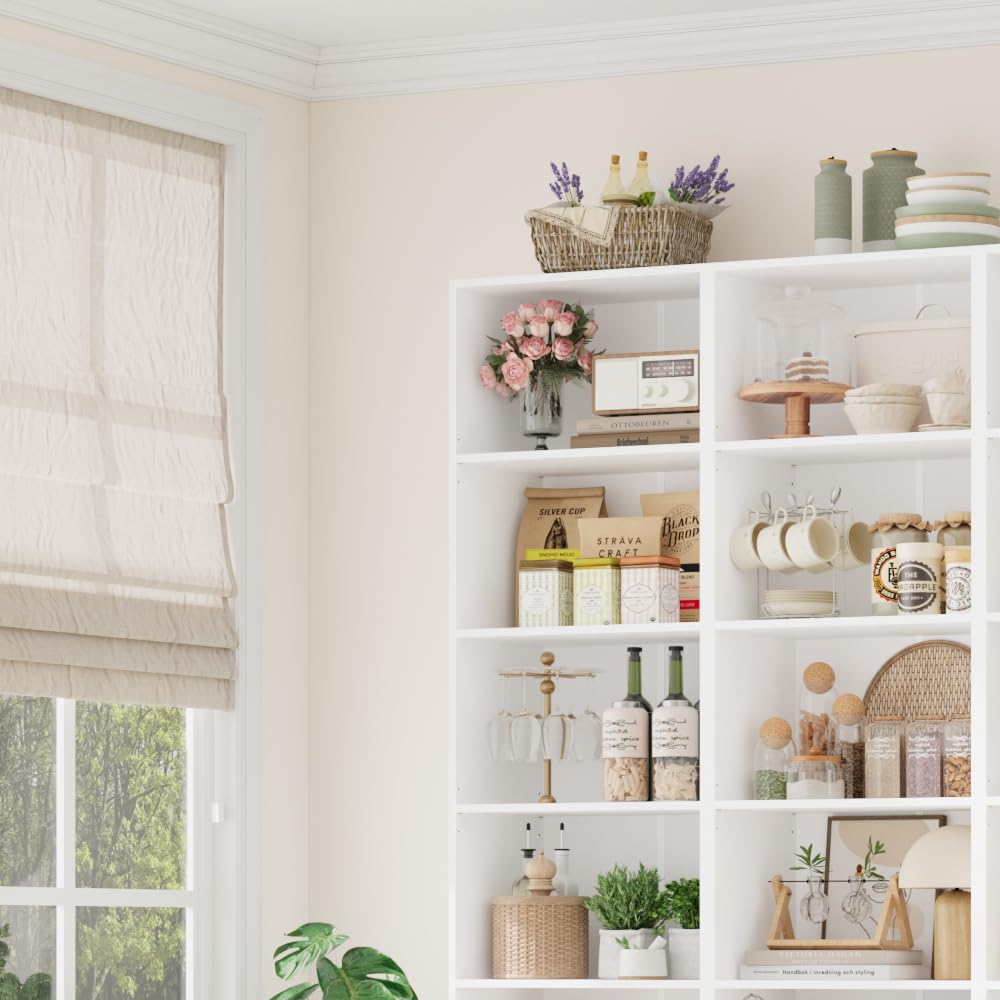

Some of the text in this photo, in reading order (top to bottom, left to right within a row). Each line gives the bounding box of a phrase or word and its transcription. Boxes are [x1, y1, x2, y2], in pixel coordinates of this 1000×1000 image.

[539, 507, 586, 516] SILVER CUP
[661, 515, 699, 537] BLACK
[598, 549, 640, 558] CRAFT
